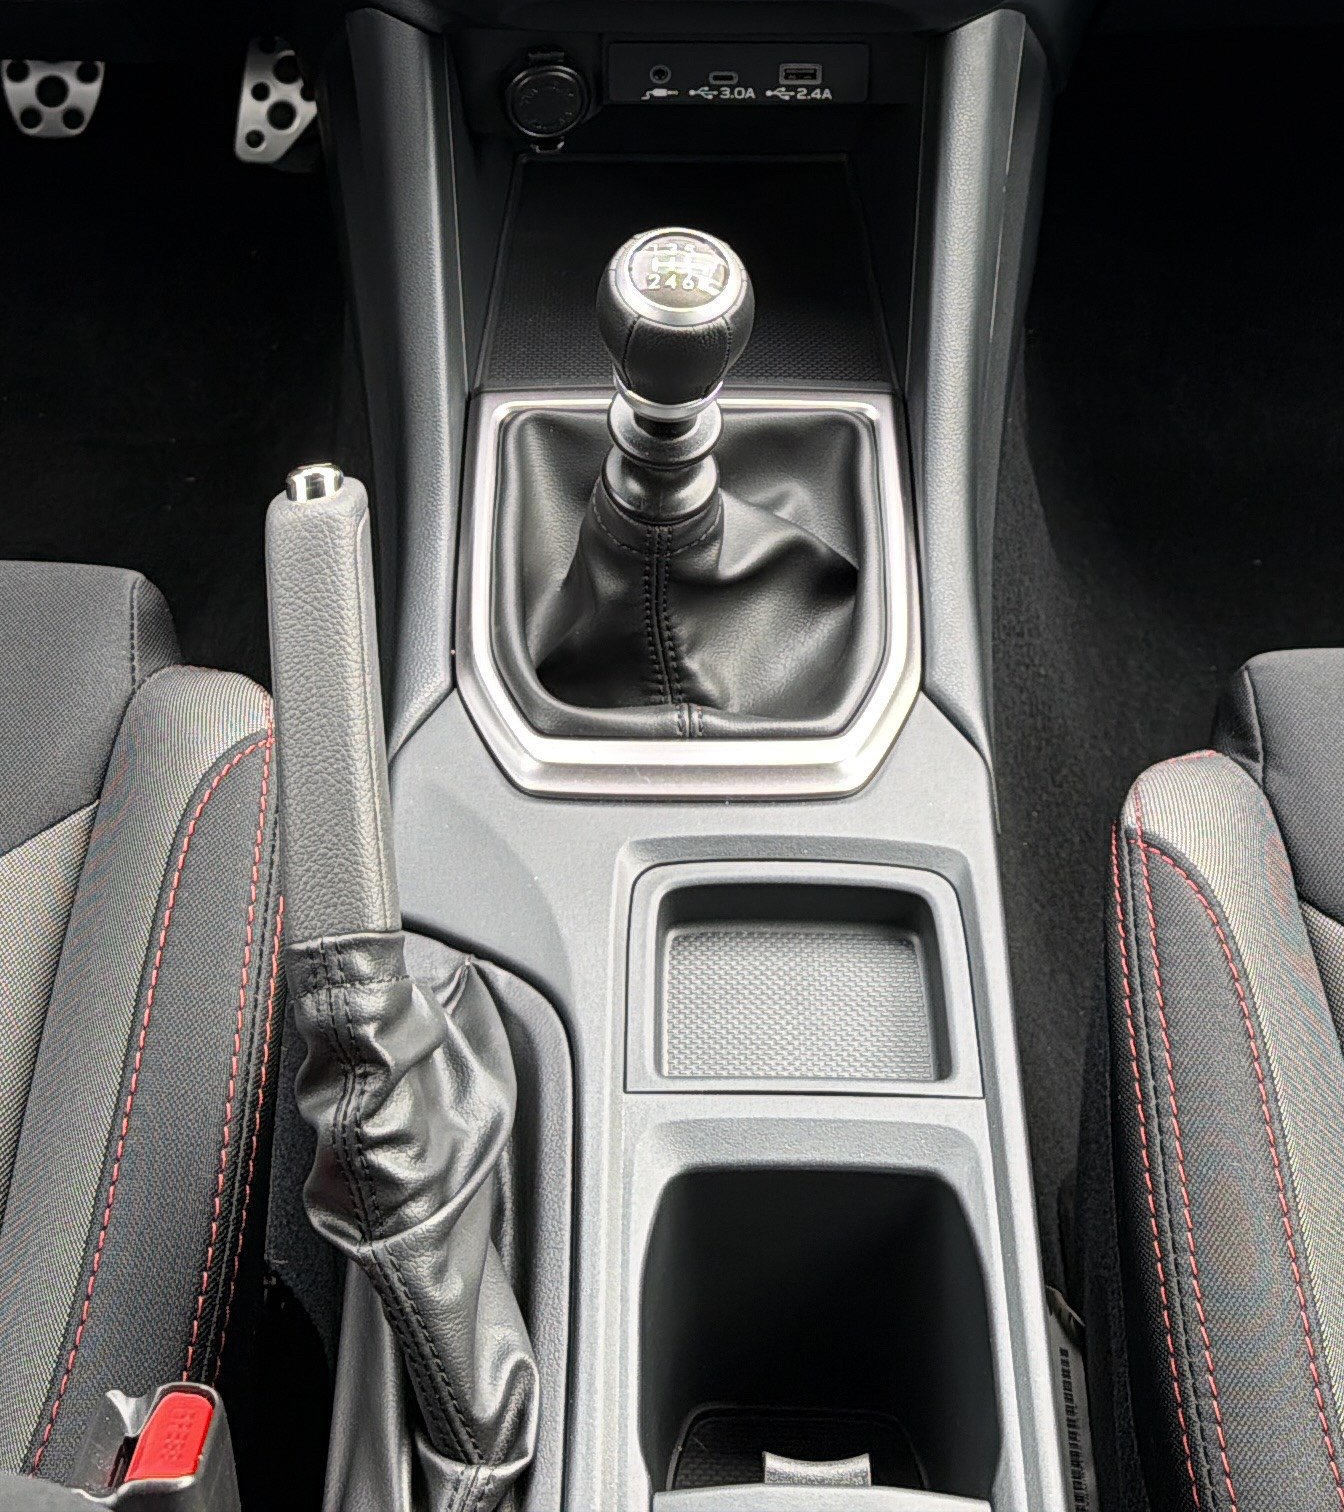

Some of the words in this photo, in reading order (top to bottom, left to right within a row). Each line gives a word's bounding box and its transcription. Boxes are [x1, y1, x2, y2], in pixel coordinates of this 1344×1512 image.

[719, 87, 755, 100] 3.0A
[796, 88, 833, 100] 2.4A
[647, 273, 661, 290] 2
[664, 273, 677, 290] 4
[682, 273, 695, 290] 6
